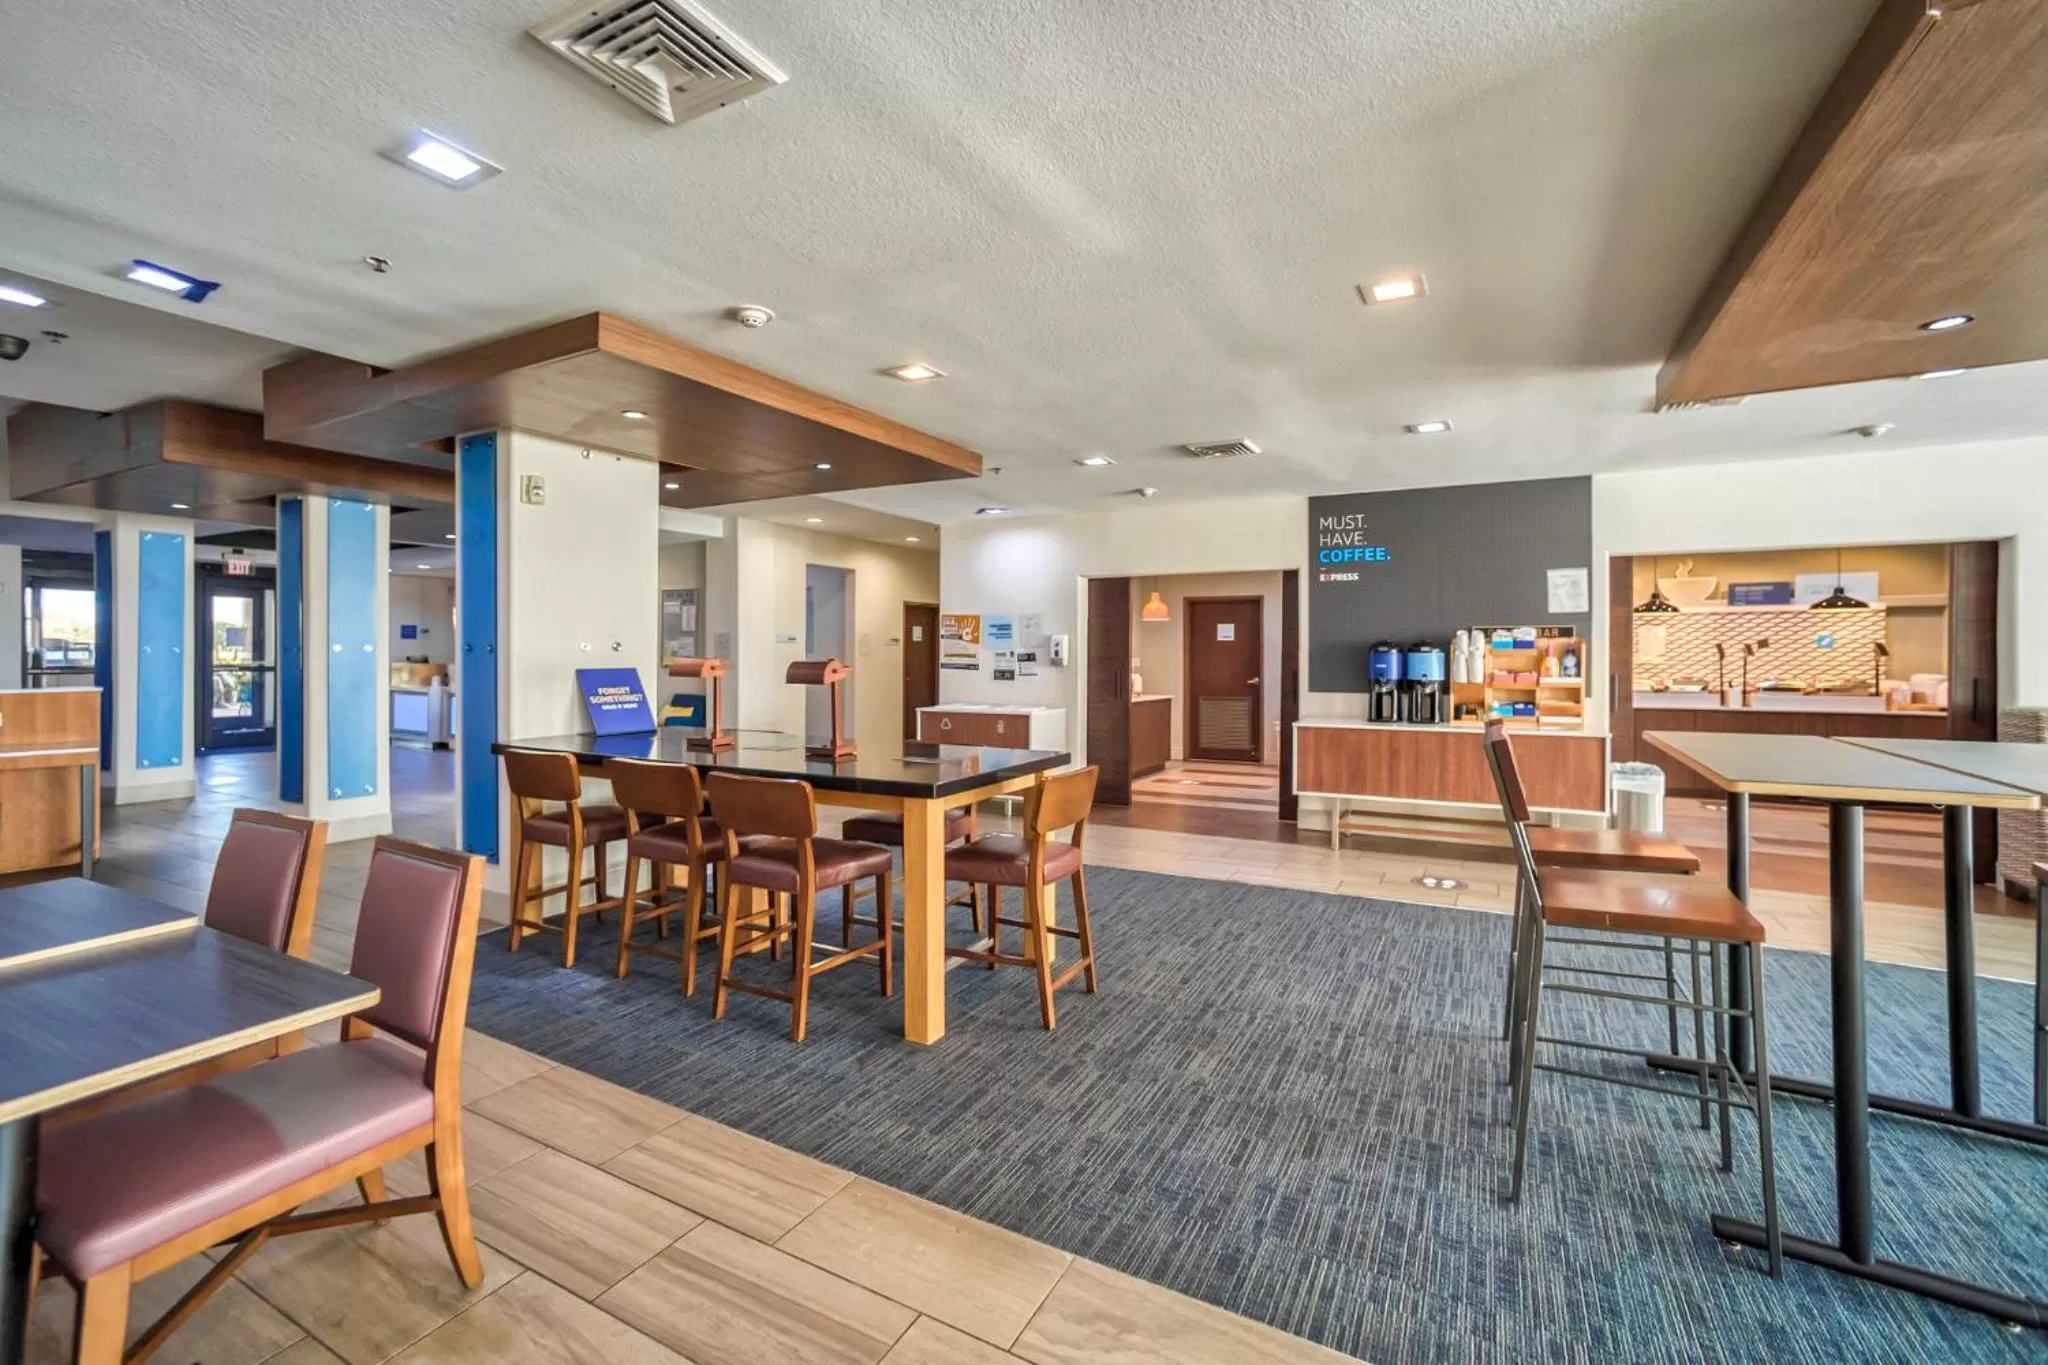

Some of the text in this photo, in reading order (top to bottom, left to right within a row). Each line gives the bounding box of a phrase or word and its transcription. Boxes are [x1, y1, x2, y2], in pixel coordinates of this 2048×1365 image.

[1320, 514, 1367, 529] MUST.
[1320, 531, 1367, 546] HAVE.
[1320, 547, 1391, 562] COFFEE.
[1319, 573, 1359, 581] EXPRESS
